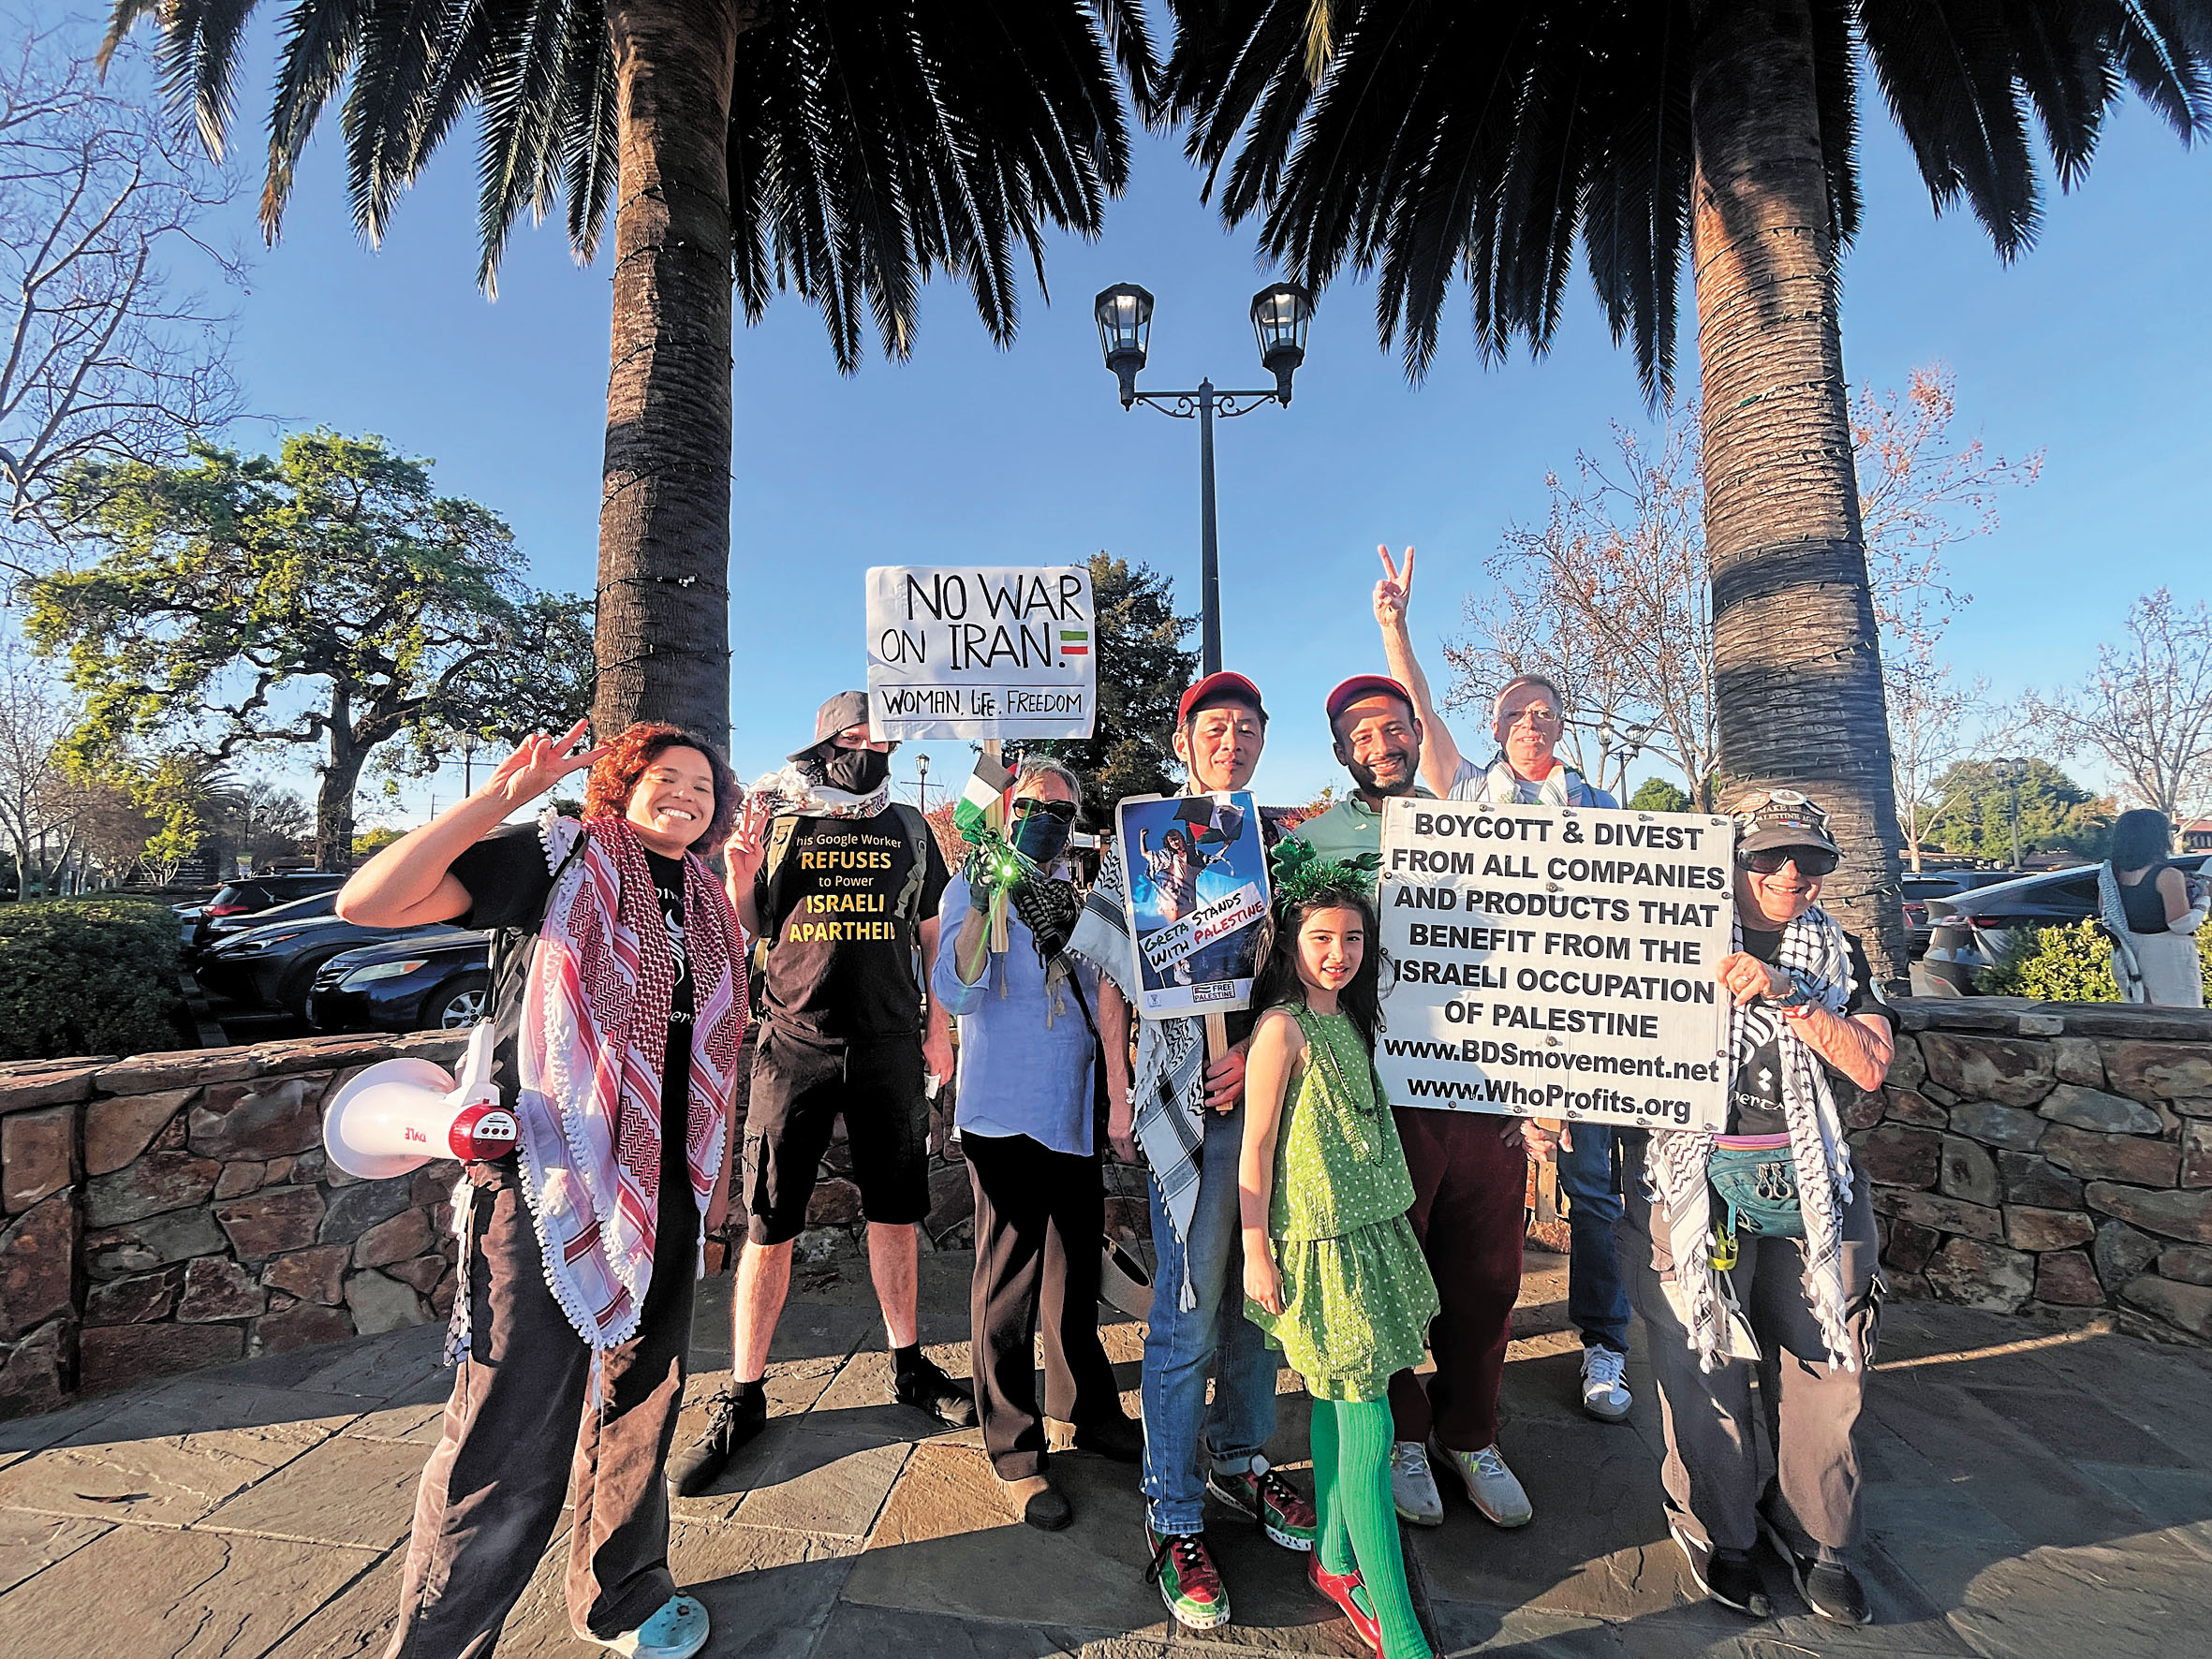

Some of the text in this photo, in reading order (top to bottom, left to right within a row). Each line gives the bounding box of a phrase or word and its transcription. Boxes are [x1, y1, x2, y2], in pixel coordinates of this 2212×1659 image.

[907, 574, 1084, 622] NO WAR
[880, 622, 1067, 671] ON IRAN.
[1007, 690, 1083, 714] FREEDOM
[796, 833, 902, 848] his Google Worker
[1414, 812, 1704, 851] BOYCOTT & DIVEST
[801, 851, 892, 870] REFUSES
[818, 875, 875, 888] to Power
[1392, 847, 1726, 890] FROM ALL COMPANIES
[806, 893, 885, 914] ISRAELI
[1143, 892, 1243, 953] GRETA STANDS
[1394, 886, 1719, 928] AND PRODUCTS THAT
[1151, 900, 1265, 968] WITH PALESTINE
[1409, 922, 1702, 965] BENEFIT FROM THE
[1194, 991, 1234, 1002] PALESTINE
[1213, 983, 1233, 993] FREE
[1394, 959, 1716, 1005] ISRAELI OCCUPATION
[1444, 1000, 1659, 1039] OF PALESTINE
[1384, 1037, 1719, 1082] www.BDSmovement.net
[1407, 1078, 1691, 1123] www.WhoProfits.org
